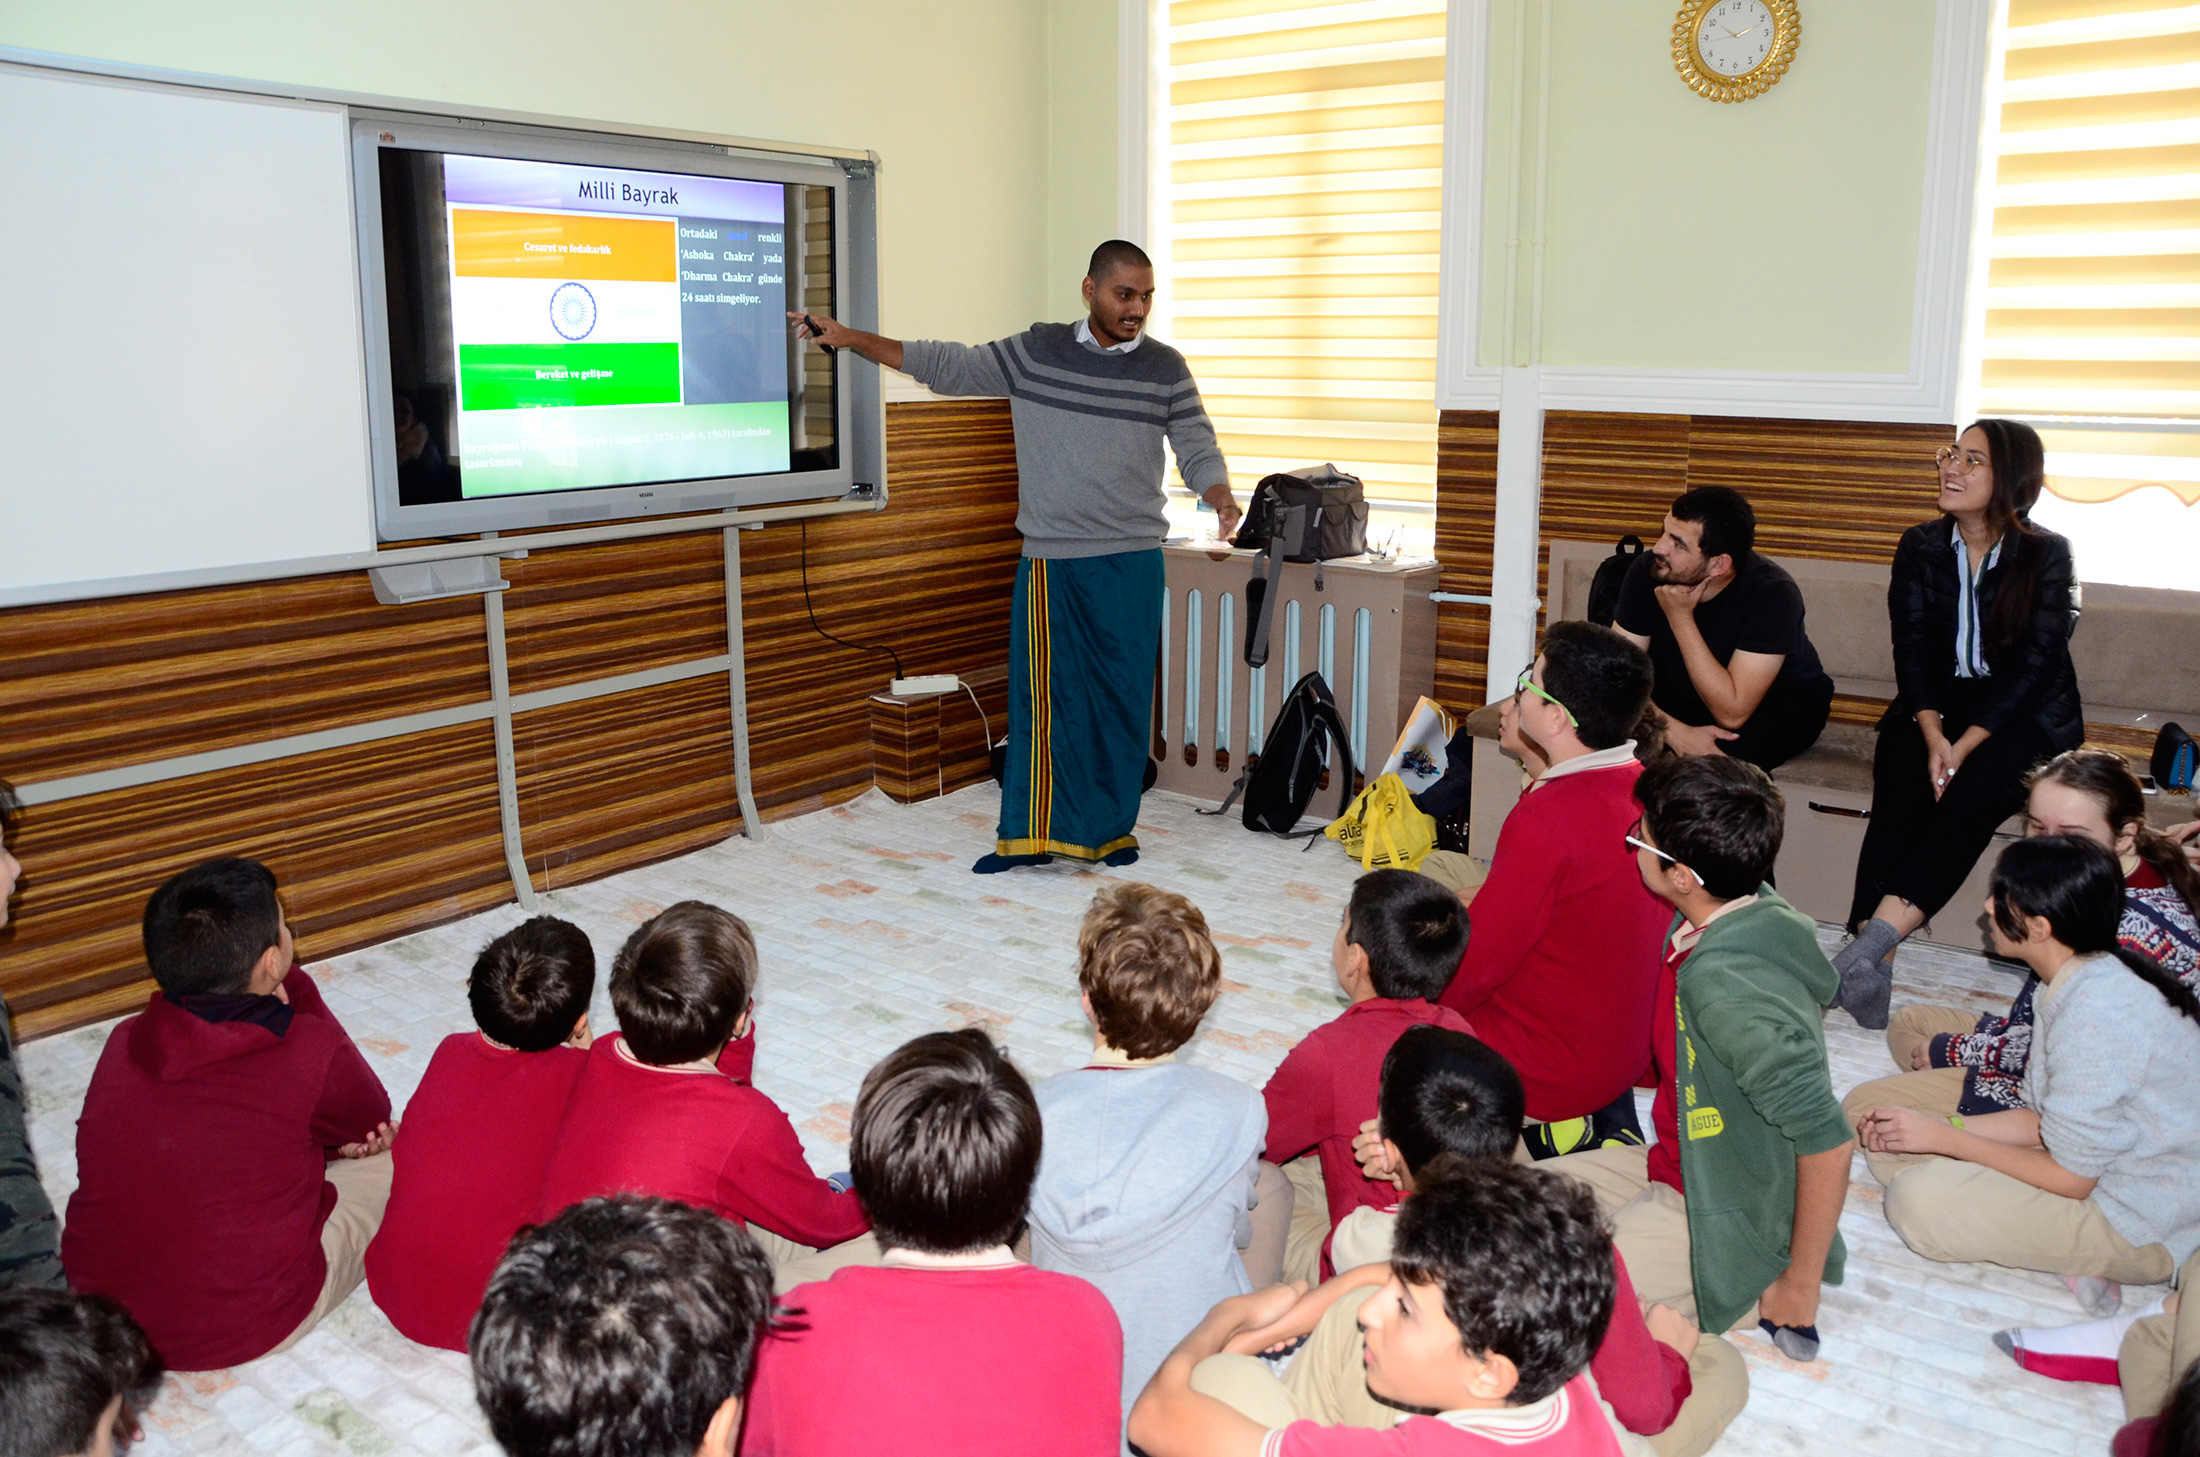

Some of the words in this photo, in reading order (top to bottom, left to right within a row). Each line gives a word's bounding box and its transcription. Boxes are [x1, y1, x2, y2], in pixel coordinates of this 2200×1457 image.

[1719, 8, 1725, 16] 11
[1733, 2, 1742, 10] 12
[1709, 19, 1717, 27] 10
[579, 180, 615, 200] Milli
[622, 184, 679, 207] Bayrak
[680, 227, 718, 240] Ortadaki
[758, 233, 782, 243] renkli
[523, 241, 557, 253] Cesaret
[558, 244, 568, 253] ve
[763, 254, 783, 265] yada
[758, 273, 783, 286] günde
[682, 292, 693, 302] 24
[716, 293, 762, 306] simgeliyor.
[535, 369, 569, 380] Bereket
[581, 369, 613, 380] gelişme
[654, 431, 675, 442] 1876
[707, 428, 730, 441] 1963)
